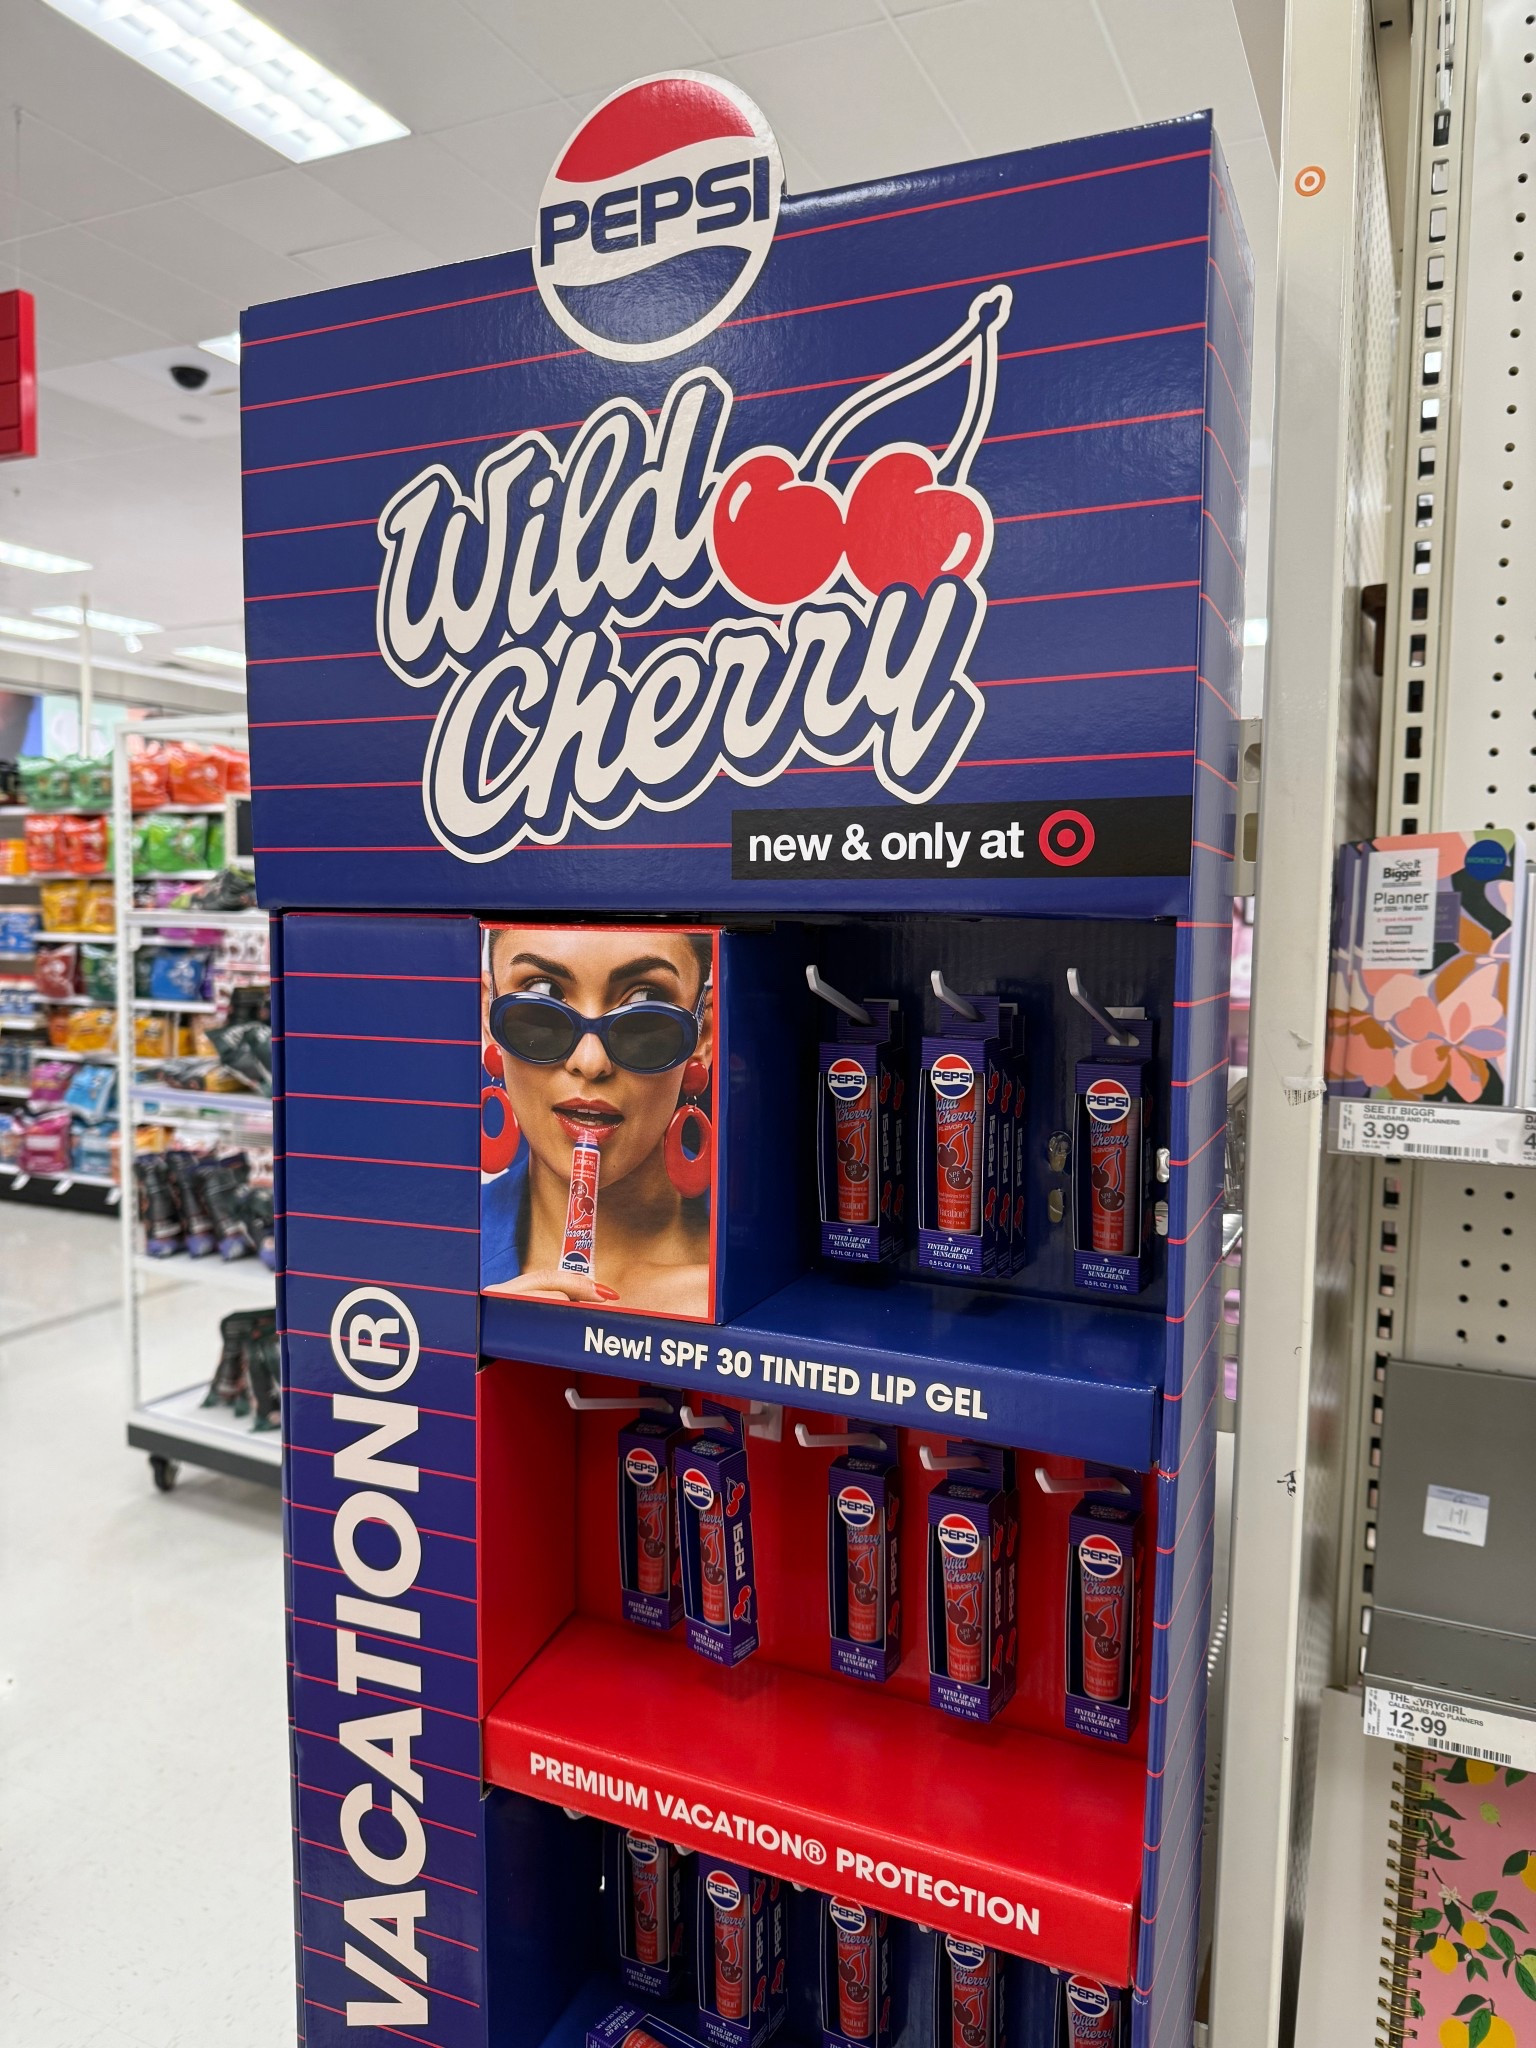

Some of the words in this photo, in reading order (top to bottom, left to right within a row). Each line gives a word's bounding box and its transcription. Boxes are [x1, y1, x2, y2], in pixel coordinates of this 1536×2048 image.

[540, 157, 770, 266] PEPSI
[388, 380, 716, 660] Wild
[434, 580, 972, 842] Cherry
[749, 834, 832, 862] new
[841, 823, 872, 861] &
[881, 822, 970, 868] only
[979, 822, 1024, 860] at
[1395, 861, 1413, 870] See
[1383, 867, 1421, 881] Bigger
[1373, 892, 1429, 904] Planner
[829, 1074, 865, 1085] PEPSI
[932, 1071, 973, 1084] PEPSI
[1087, 1095, 1129, 1107] PEPSI
[838, 1108, 872, 1121] Cherry
[937, 1110, 976, 1124] Cherry
[1363, 1114, 1405, 1122] CALENDARS
[1364, 1105, 1384, 1114] SEE
[1388, 1106, 1397, 1115] IT
[1400, 1107, 1435, 1117] BIGGR
[1363, 1121, 1409, 1140] 3.99
[988, 1114, 996, 1178] PEPSI
[1092, 1134, 1129, 1148] Cherry
[833, 1240, 866, 1249] SUNSCREEN
[927, 1242, 949, 1251] TINTED
[932, 1250, 968, 1260] SUNSCREEN
[562, 1261, 589, 1274] PEPSI
[1082, 1263, 1105, 1271] TINTED
[1118, 1268, 1130, 1276] GEL
[1088, 1271, 1124, 1280] SUNSCREEN
[584, 1326, 652, 1362] New!
[660, 1338, 708, 1371] SPF
[717, 1348, 752, 1379] 30
[760, 1355, 860, 1397] TINTED
[870, 1372, 916, 1406] LIP
[925, 1383, 988, 1420] GEL
[628, 1459, 658, 1474] PEPSI
[684, 1479, 712, 1498] PEPSI
[839, 1499, 873, 1514] PEPSI
[848, 1531, 880, 1545] Cherry
[939, 1528, 978, 1544] PEPSI
[733, 1521, 746, 1582] PEPSI
[1081, 1547, 1121, 1565] PEPSI
[945, 1570, 985, 1584] Cherry
[1084, 1582, 1125, 1597] Cherry
[331, 1286, 429, 2027] VACATION®
[938, 1687, 959, 1697] TINTED
[959, 1692, 969, 1700] LIP
[970, 1696, 981, 1704] GEL
[943, 1694, 976, 1709] SUNSCREEN
[1389, 1692, 1410, 1704] THE
[1074, 1707, 1096, 1718] TINTED
[1109, 1717, 1120, 1725] GEL
[1389, 1701, 1429, 1715] CALENDARS
[1431, 1710, 1445, 1718] AND
[1447, 1714, 1483, 1727] PLANNERS
[1080, 1715, 1114, 1730] SUNSCREEN
[1389, 1709, 1447, 1737] 12.99
[530, 1752, 648, 1811] PREMIUM
[654, 1790, 827, 1865] VACATION®
[837, 1846, 1040, 1936] PROTECTION
[627, 1838, 657, 1854] PEPSI
[708, 1881, 739, 1900] PEPSI
[715, 1910, 745, 1929] Cherry
[831, 1904, 865, 1923] PEPSI
[839, 1931, 873, 1947] Cherry
[947, 1939, 984, 1958] PEPSI
[954, 1970, 990, 1989] Cherry
[1069, 1984, 1107, 2007] PEPSI
[1071, 2012, 1099, 2027] Wild
[706, 2022, 723, 2033] TINTED
[723, 2028, 733, 2037] LIP
[733, 2032, 743, 2042] GEL
[710, 2029, 738, 2045] SUNSCREEN
[1075, 2025, 1113, 2039] Cherry
